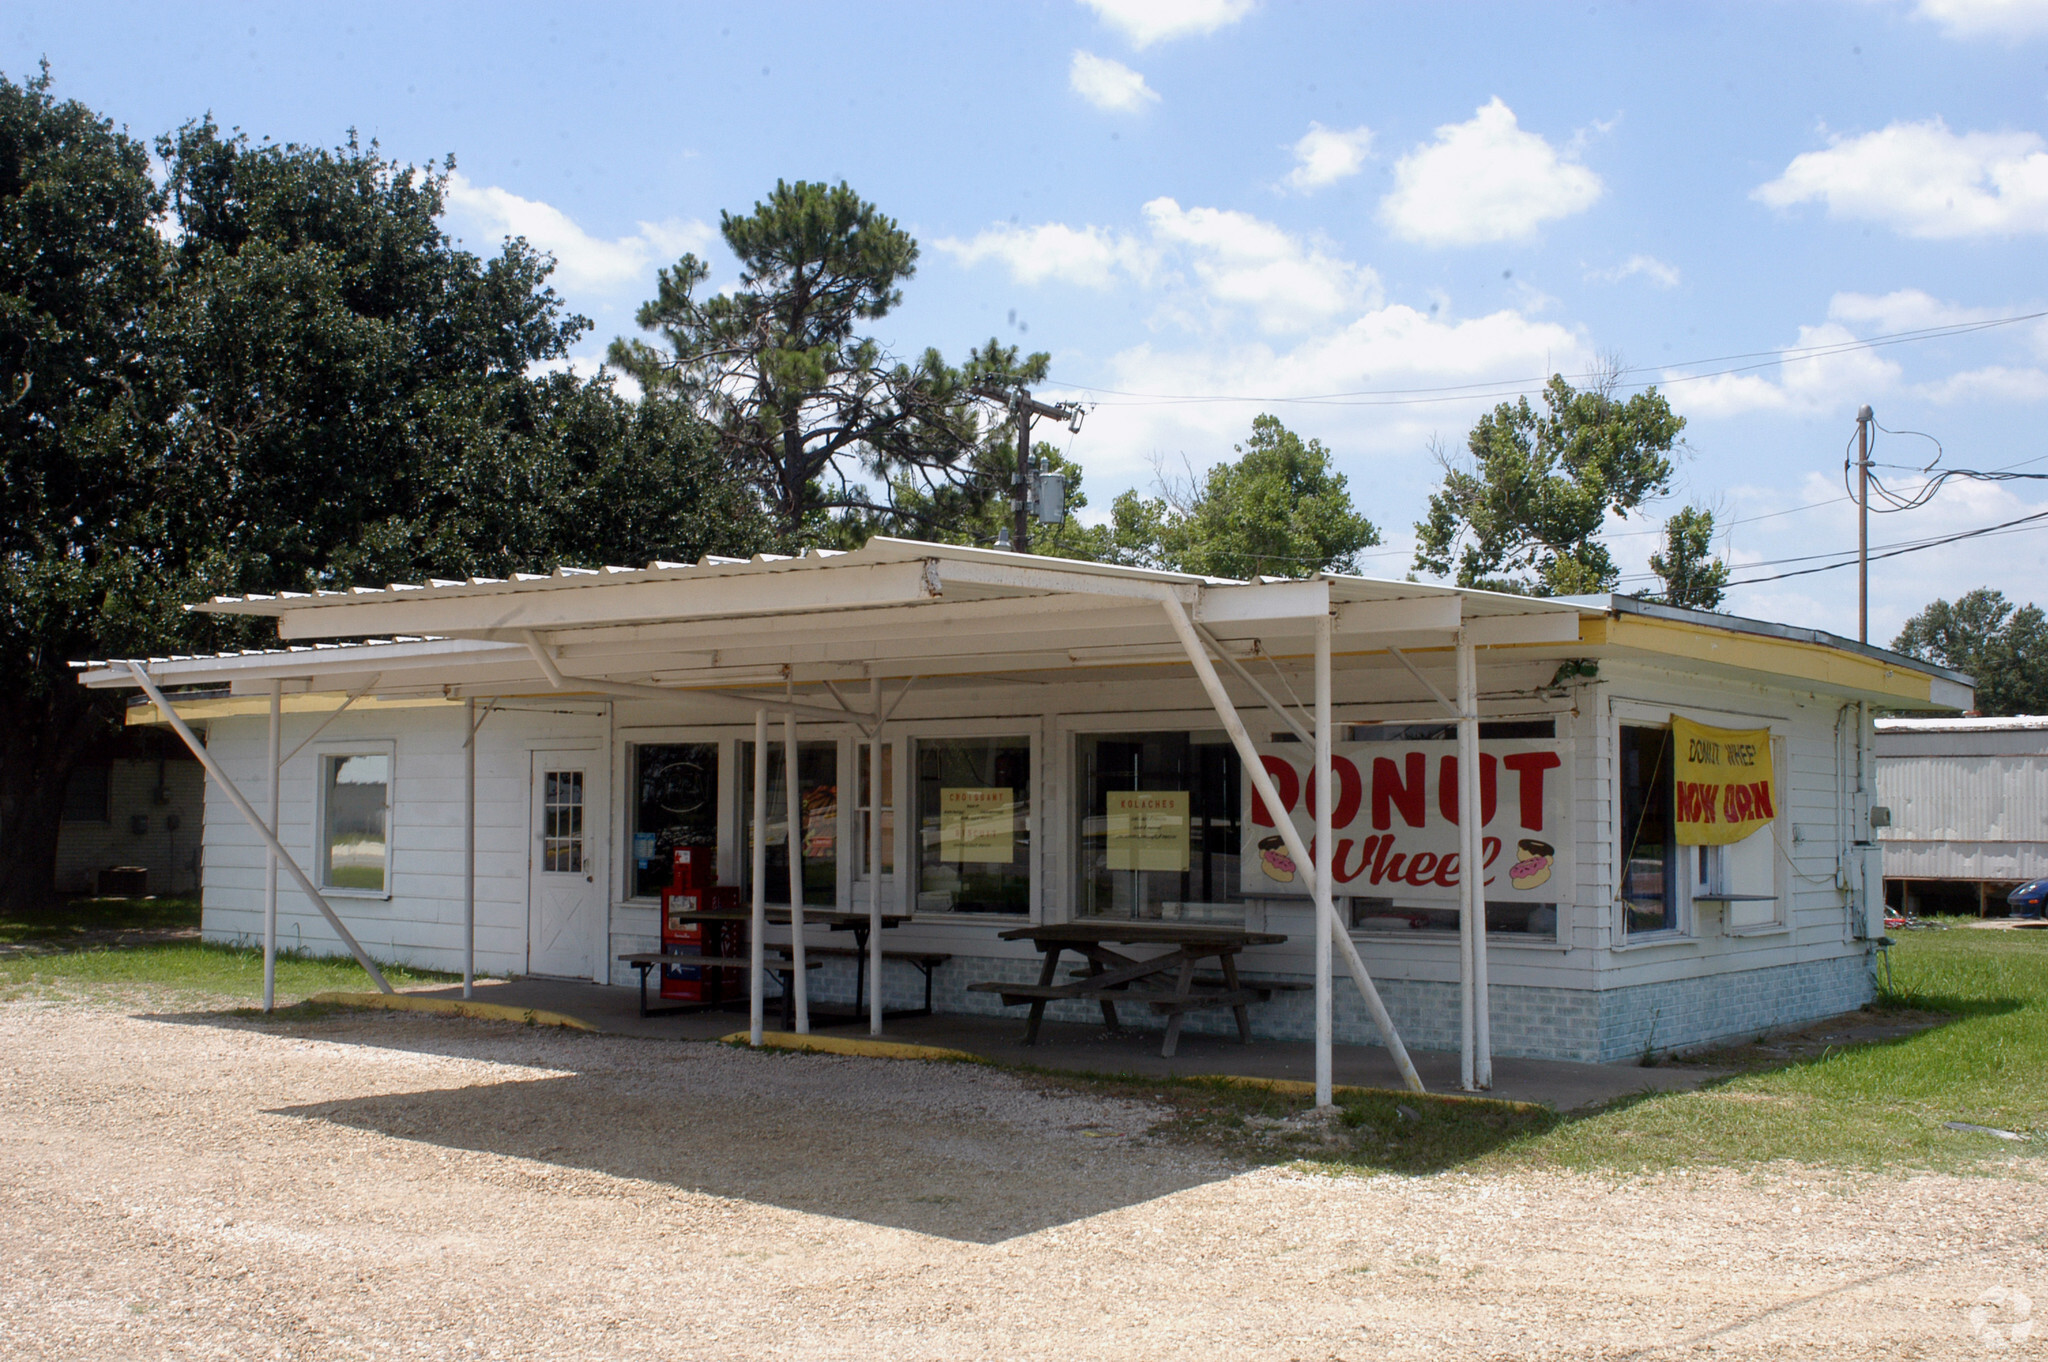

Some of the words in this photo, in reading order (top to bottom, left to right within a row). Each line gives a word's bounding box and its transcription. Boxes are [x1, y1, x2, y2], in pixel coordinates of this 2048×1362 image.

[1688, 738, 1720, 766] DONUT
[1120, 799, 1175, 809] KOLACHES
[1251, 751, 1562, 832] DONUT
[1677, 780, 1720, 824] NOW
[1308, 834, 1502, 888] Wheel
